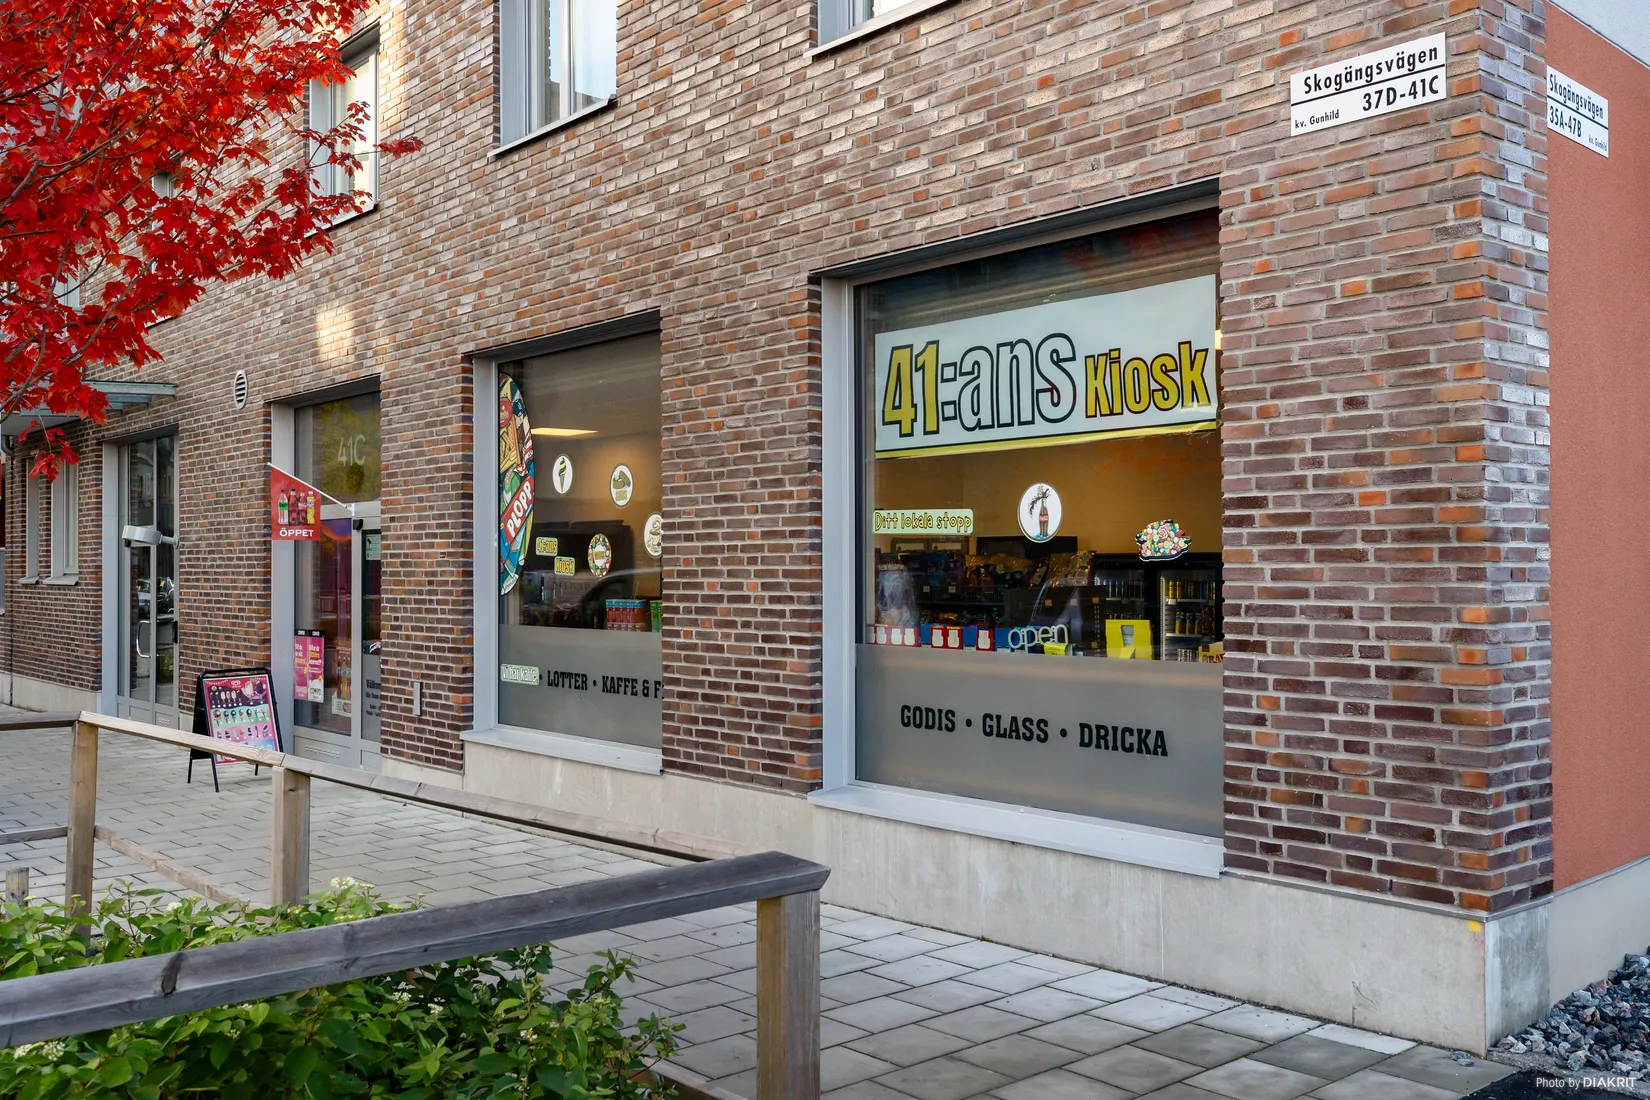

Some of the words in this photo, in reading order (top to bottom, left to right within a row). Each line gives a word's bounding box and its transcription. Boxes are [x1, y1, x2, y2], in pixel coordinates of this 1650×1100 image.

[1304, 47, 1438, 94] Skogängsvägen
[1362, 75, 1439, 111] 37D-41C
[1549, 74, 1604, 119] Skogängsvägen
[1295, 119, 1307, 129] kv.
[1309, 109, 1340, 125] Gunhild
[1549, 105, 1582, 137] 35A-47B
[882, 332, 1076, 438] 41:ans
[1084, 340, 1211, 418] Kiosk
[337, 434, 366, 467] 41C
[506, 480, 532, 538] PLOPP
[874, 511, 898, 531] Ditt
[901, 512, 933, 529] lokala
[936, 511, 972, 533] stopp
[279, 527, 314, 537] ÖPPET
[1007, 623, 1069, 655] open
[547, 670, 588, 691] LOTTER
[601, 675, 638, 697] KAFFE
[642, 679, 650, 698] &
[900, 704, 956, 732] GODIS
[982, 713, 1049, 743] GLASS
[1078, 722, 1169, 757] DRICKA
